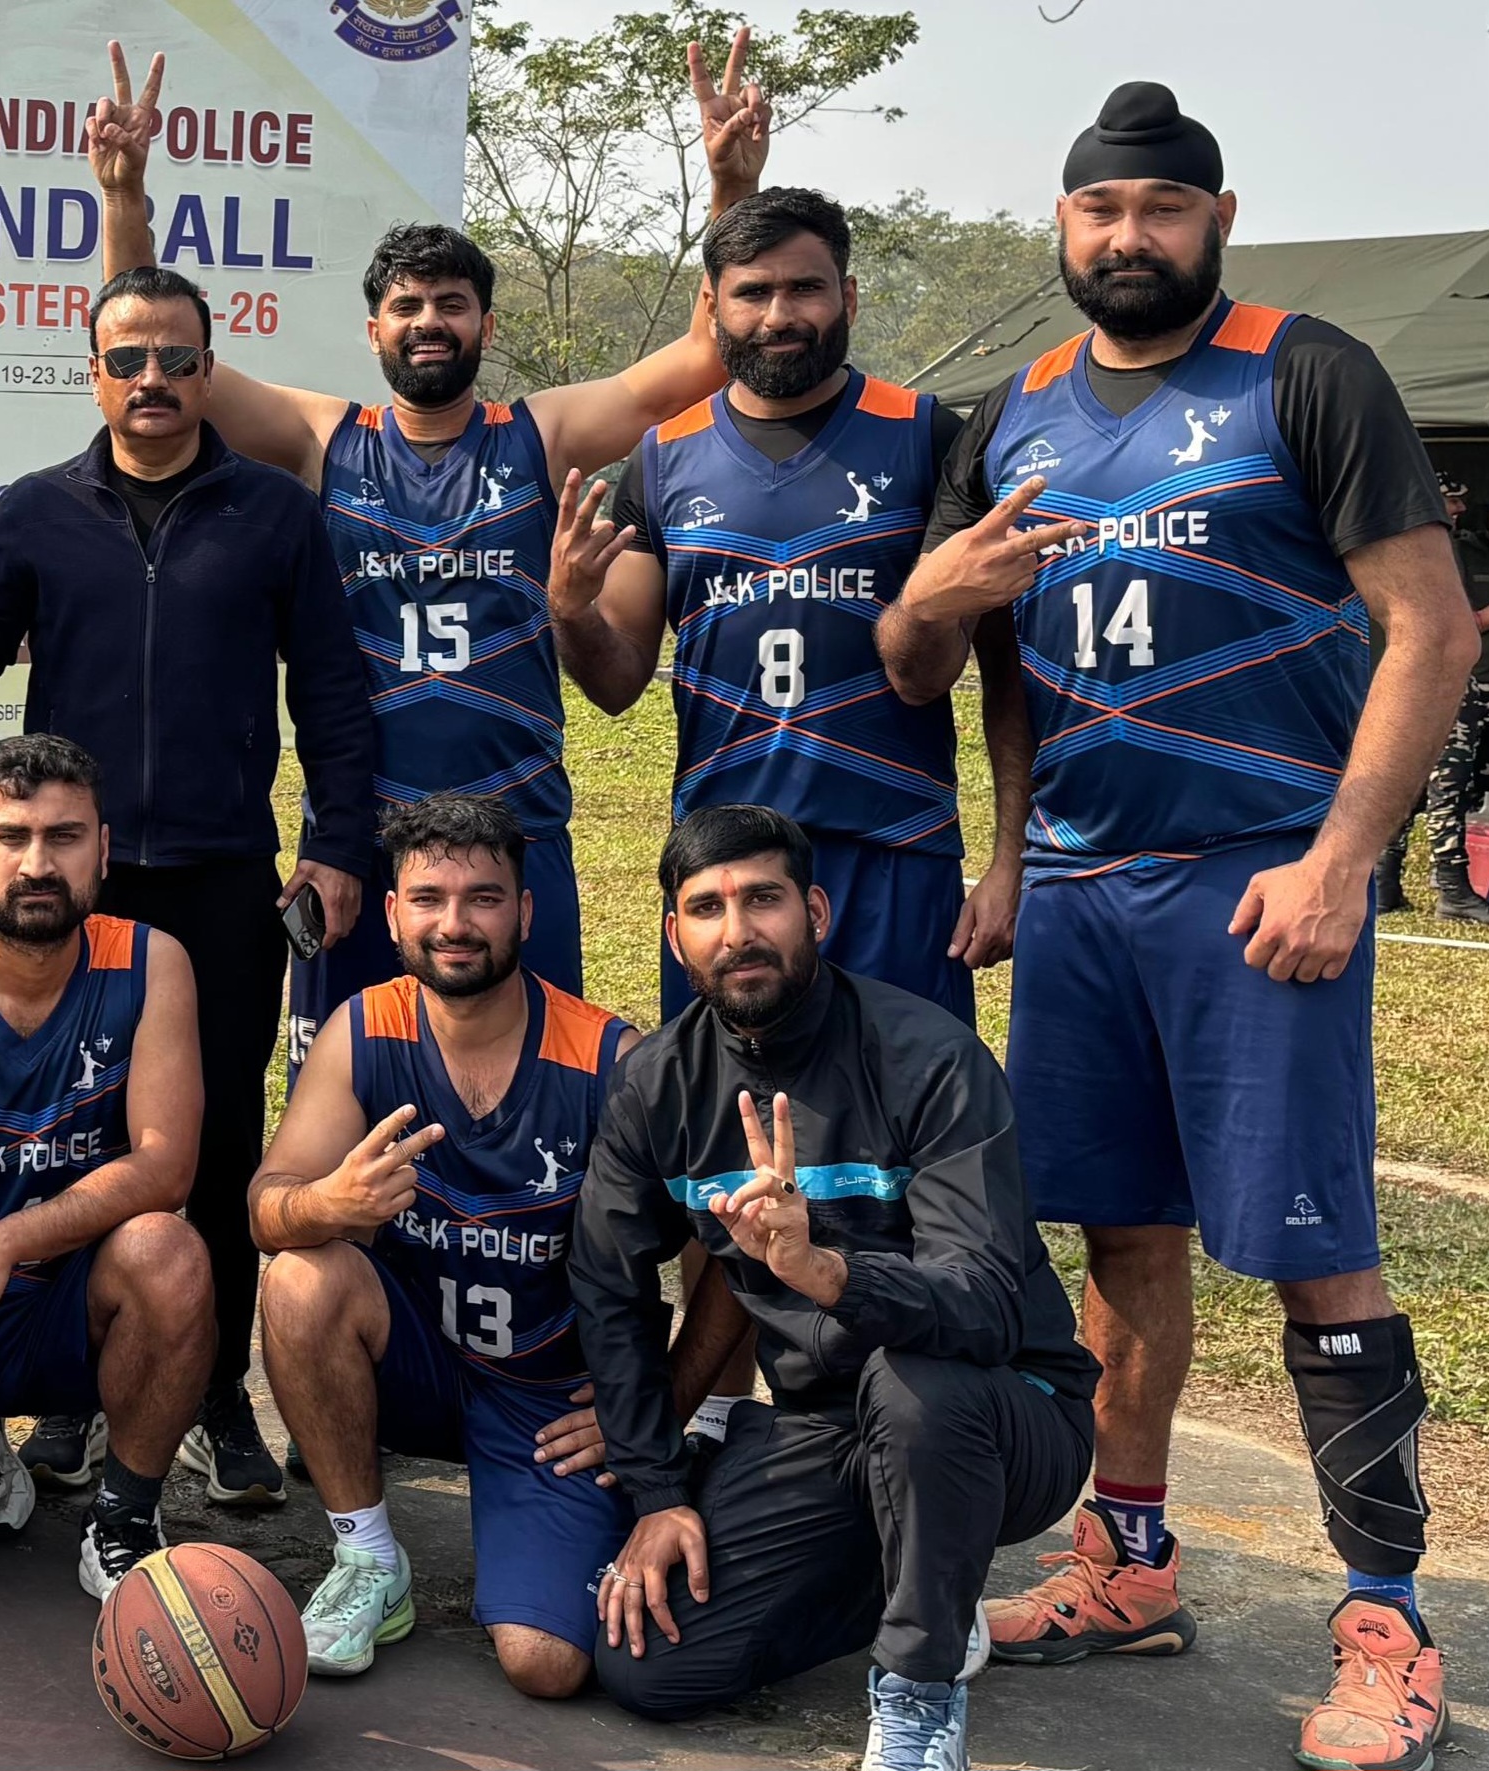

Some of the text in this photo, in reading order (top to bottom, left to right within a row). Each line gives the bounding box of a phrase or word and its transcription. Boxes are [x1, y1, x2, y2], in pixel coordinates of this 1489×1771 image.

[1, 365, 55, 384] 19-23
[1016, 458, 1061, 475] GOLD SPOT
[1098, 509, 1210, 555] POLICE
[356, 549, 515, 583] J&K POLICE
[703, 564, 876, 607] J&K POLICE
[399, 602, 470, 672] 15
[1072, 579, 1155, 668] 14
[758, 628, 805, 708] 8
[19, 1127, 103, 1176] POLICE
[393, 1209, 566, 1265] J&K POLICE
[1285, 1215, 1324, 1226] GOLD SPOT
[438, 1276, 513, 1359] 13
[1331, 1333, 1362, 1356] NBA
